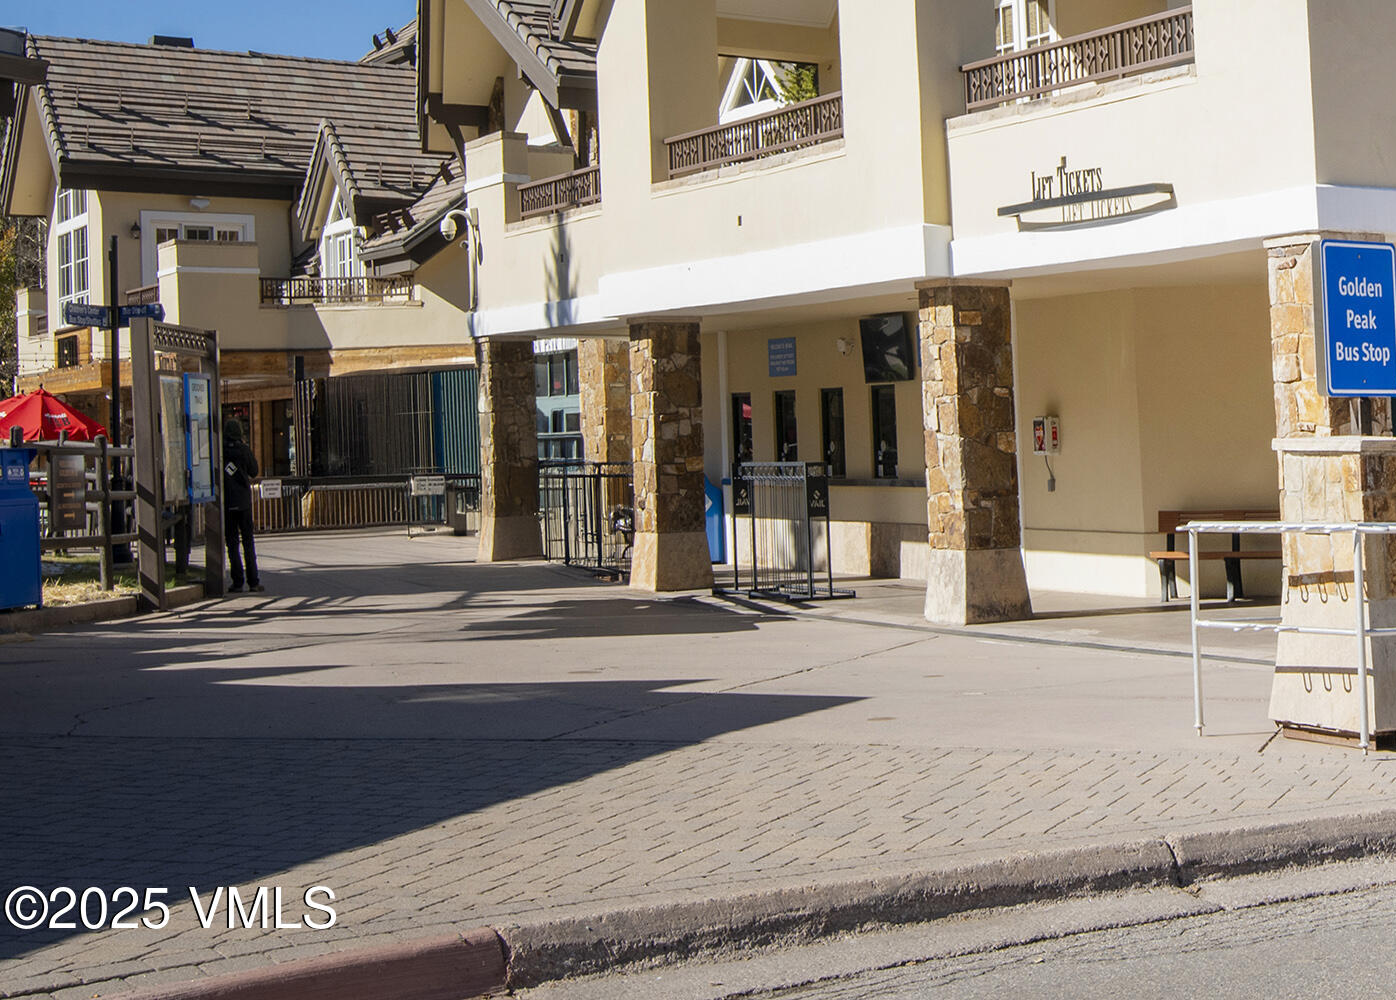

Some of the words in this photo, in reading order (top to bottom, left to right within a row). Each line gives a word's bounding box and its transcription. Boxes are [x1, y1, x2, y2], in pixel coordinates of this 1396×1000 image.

[1338, 275, 1383, 298] Golden
[1346, 308, 1377, 330] Peak
[1335, 341, 1360, 362] Bus
[1361, 342, 1391, 367] Stop
